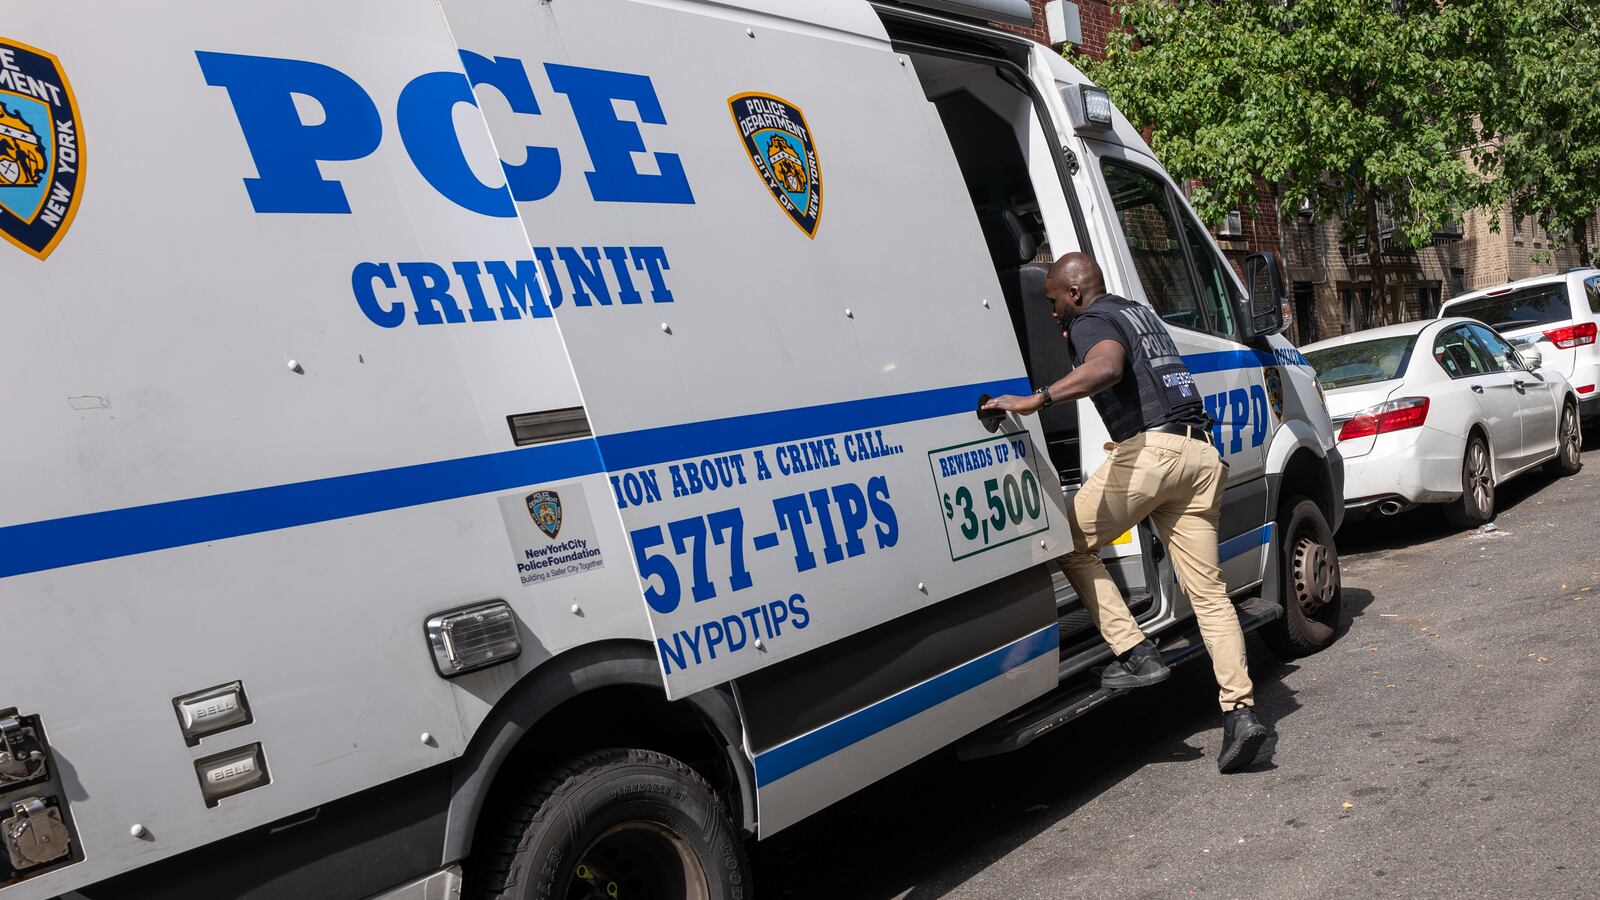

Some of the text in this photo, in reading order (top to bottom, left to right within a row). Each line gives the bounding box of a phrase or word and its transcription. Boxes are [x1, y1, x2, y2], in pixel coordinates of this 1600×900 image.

[739, 114, 808, 142] DEPARTMENT
[746, 98, 788, 119] POLICE
[40, 119, 77, 229] NEW YORK
[753, 154, 796, 213] CITY OF
[807, 150, 820, 220] NEW YORK
[1203, 383, 1268, 458] YPD
[610, 429, 904, 510] ION ABOUT A CRIME CALL...
[939, 440, 1026, 478] REWARDS UP TO
[943, 468, 1041, 545] $3,500
[520, 573, 546, 584] Building
[551, 567, 566, 577] Safer
[566, 564, 579, 573] City
[578, 559, 603, 571] Together
[630, 475, 900, 615] 577-TIPS
[657, 592, 811, 675] NYPDTIPS
[196, 703, 234, 719] BELL
[214, 765, 250, 782] BELL
